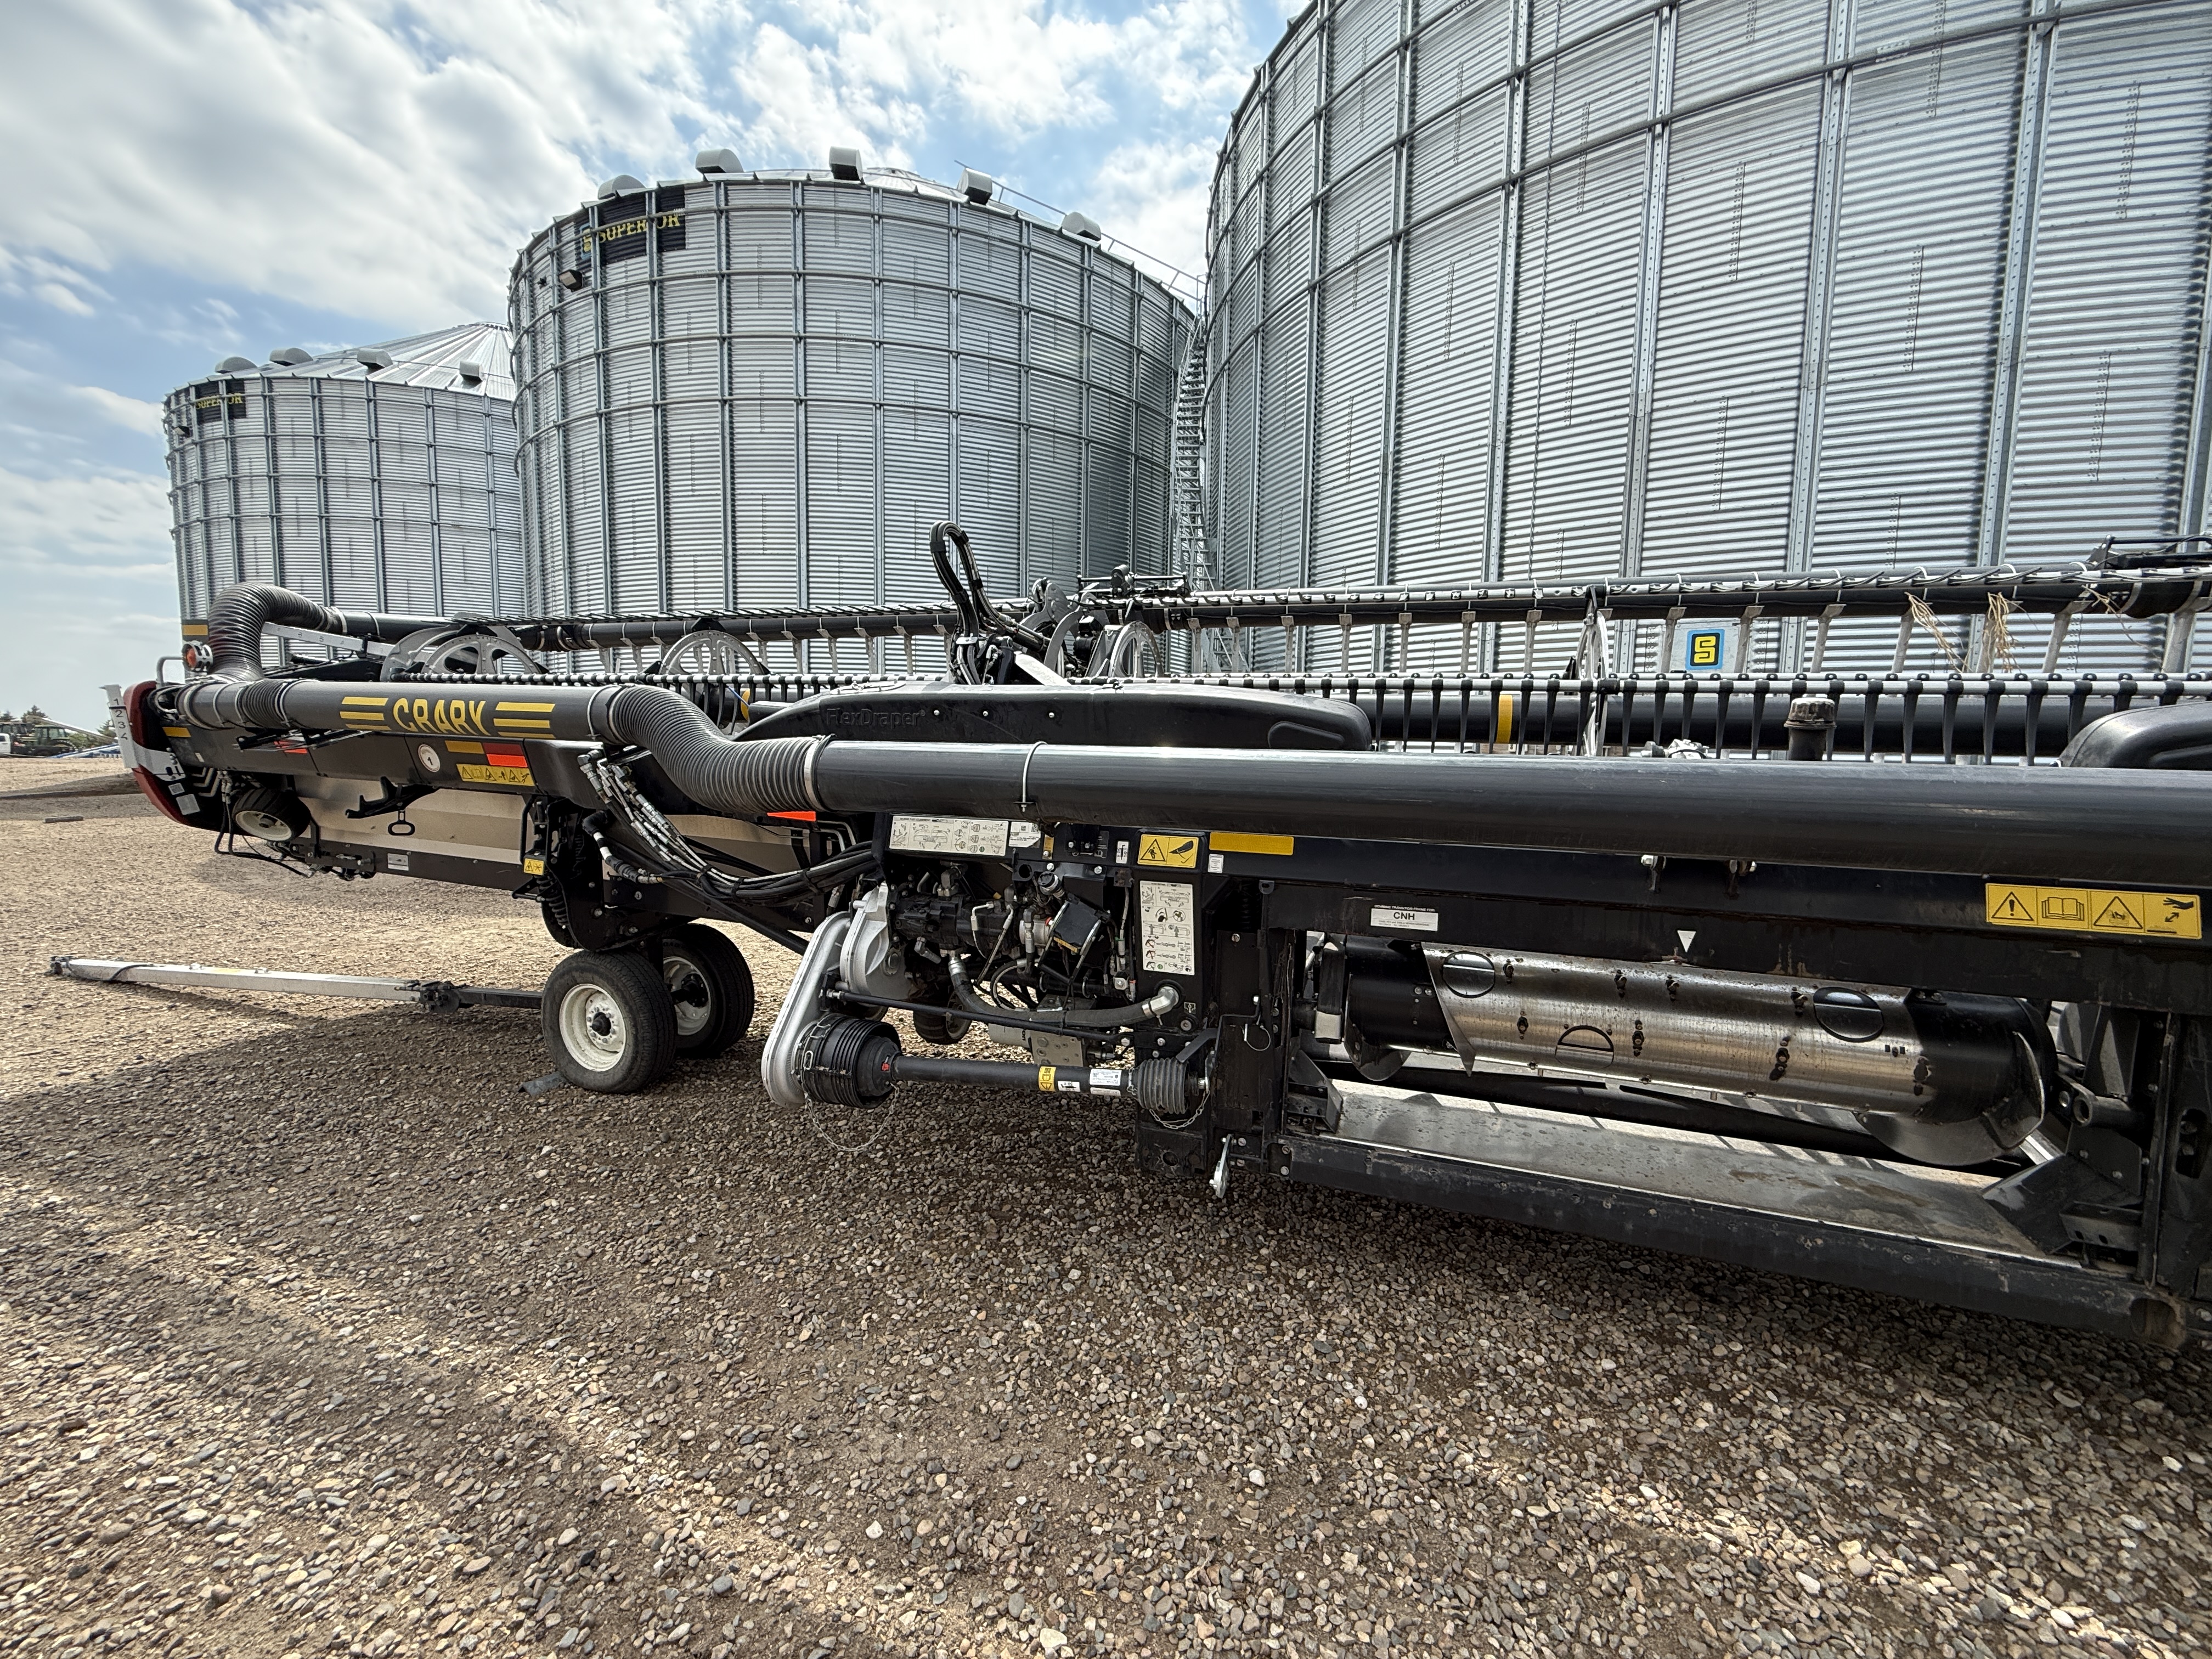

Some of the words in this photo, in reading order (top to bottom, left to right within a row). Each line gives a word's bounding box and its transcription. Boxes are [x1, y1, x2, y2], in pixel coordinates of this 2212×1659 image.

[597, 214, 680, 244] SUPEROR
[1694, 636, 1716, 663] S
[115, 709, 124, 718] 2
[393, 698, 491, 736] CRARY
[427, 757, 433, 766] 1
[1393, 911, 1415, 921] CNH
